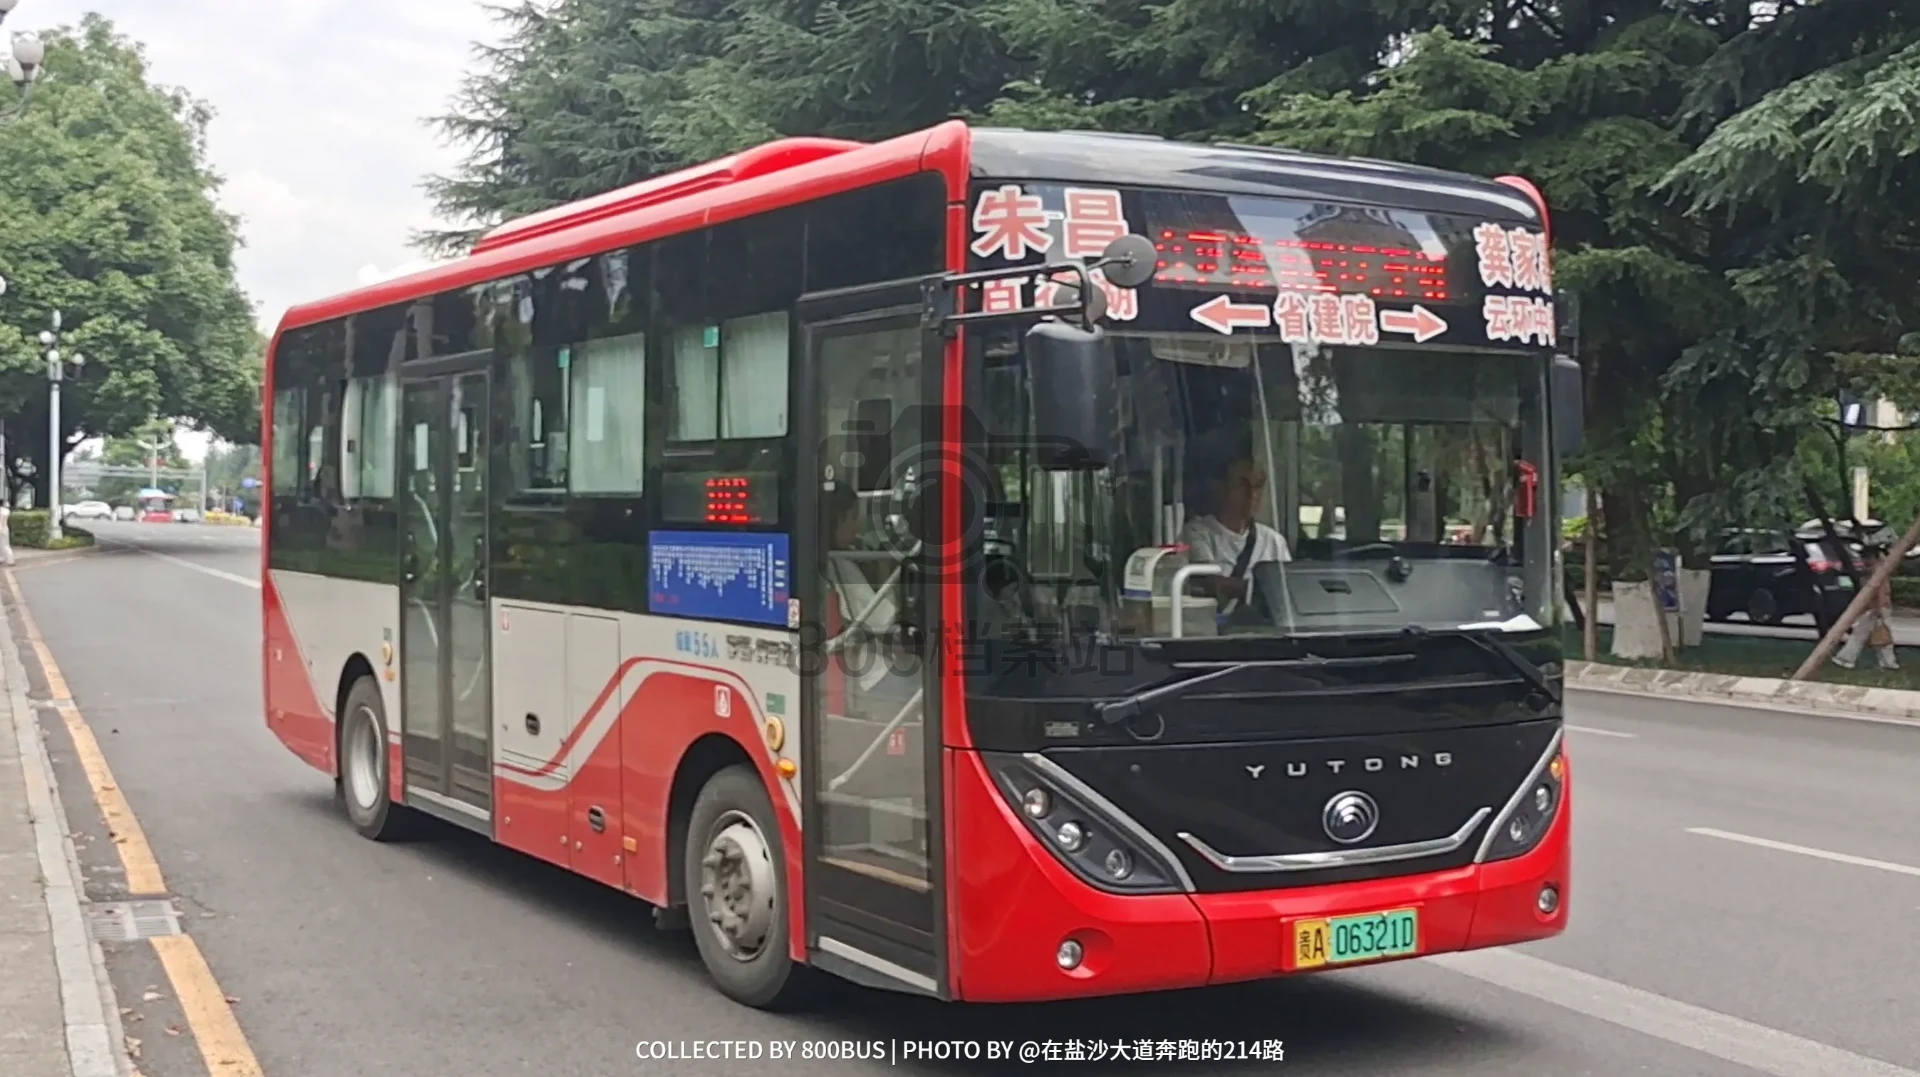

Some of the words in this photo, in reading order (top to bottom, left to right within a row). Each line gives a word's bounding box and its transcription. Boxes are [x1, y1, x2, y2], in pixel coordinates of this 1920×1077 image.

[971, 185, 1129, 260] 朱昌
[1274, 293, 1378, 345] 省建院
[1483, 295, 1555, 347] 云环中
[1246, 753, 1452, 779] YUTONG
